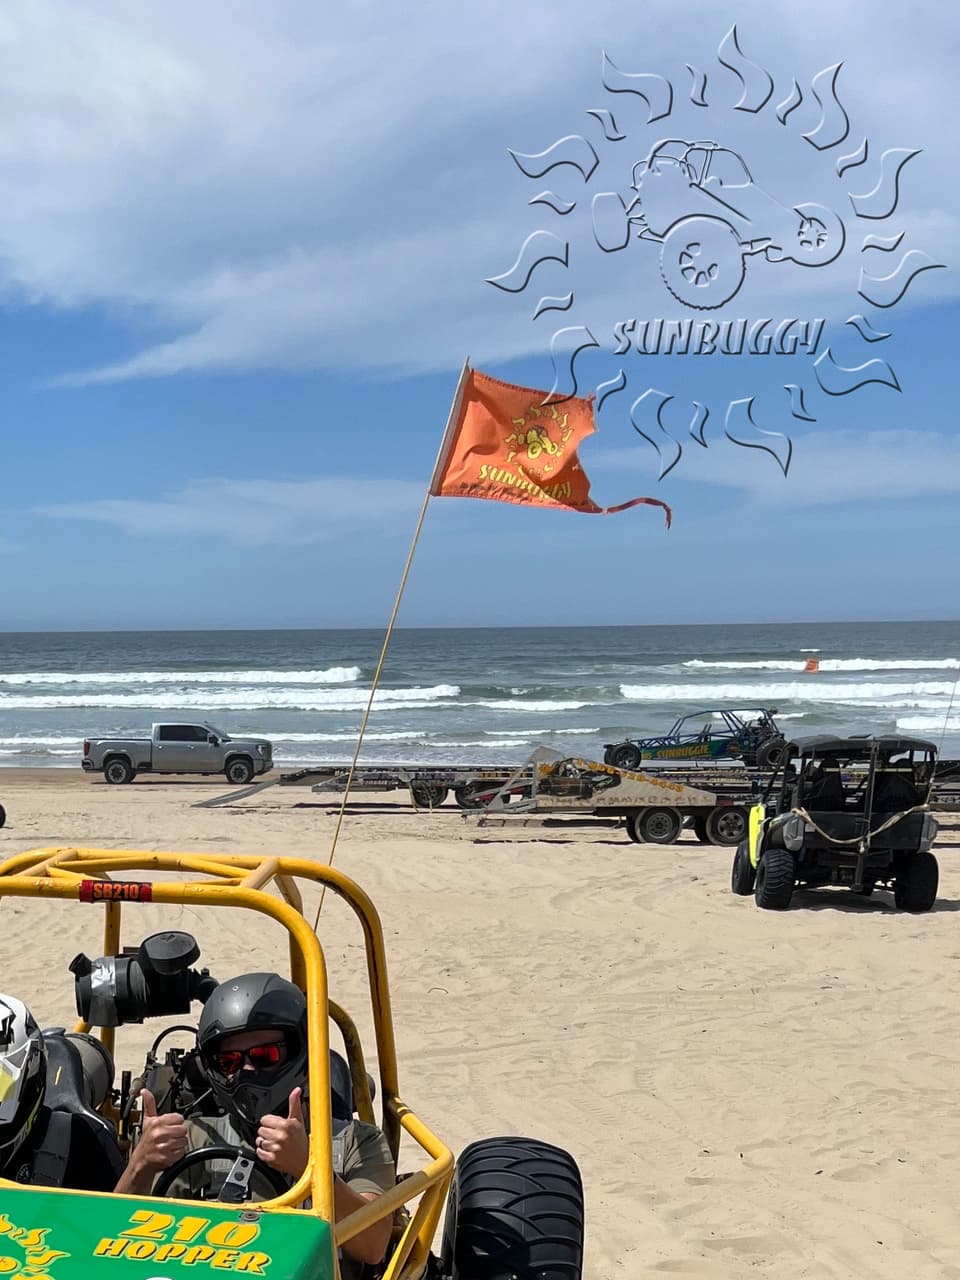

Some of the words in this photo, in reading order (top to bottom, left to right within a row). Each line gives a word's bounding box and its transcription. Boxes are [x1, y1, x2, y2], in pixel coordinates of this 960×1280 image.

[93, 882, 139, 899] SB210
[118, 1210, 261, 1248] 210
[93, 1238, 272, 1276] HOPPER
